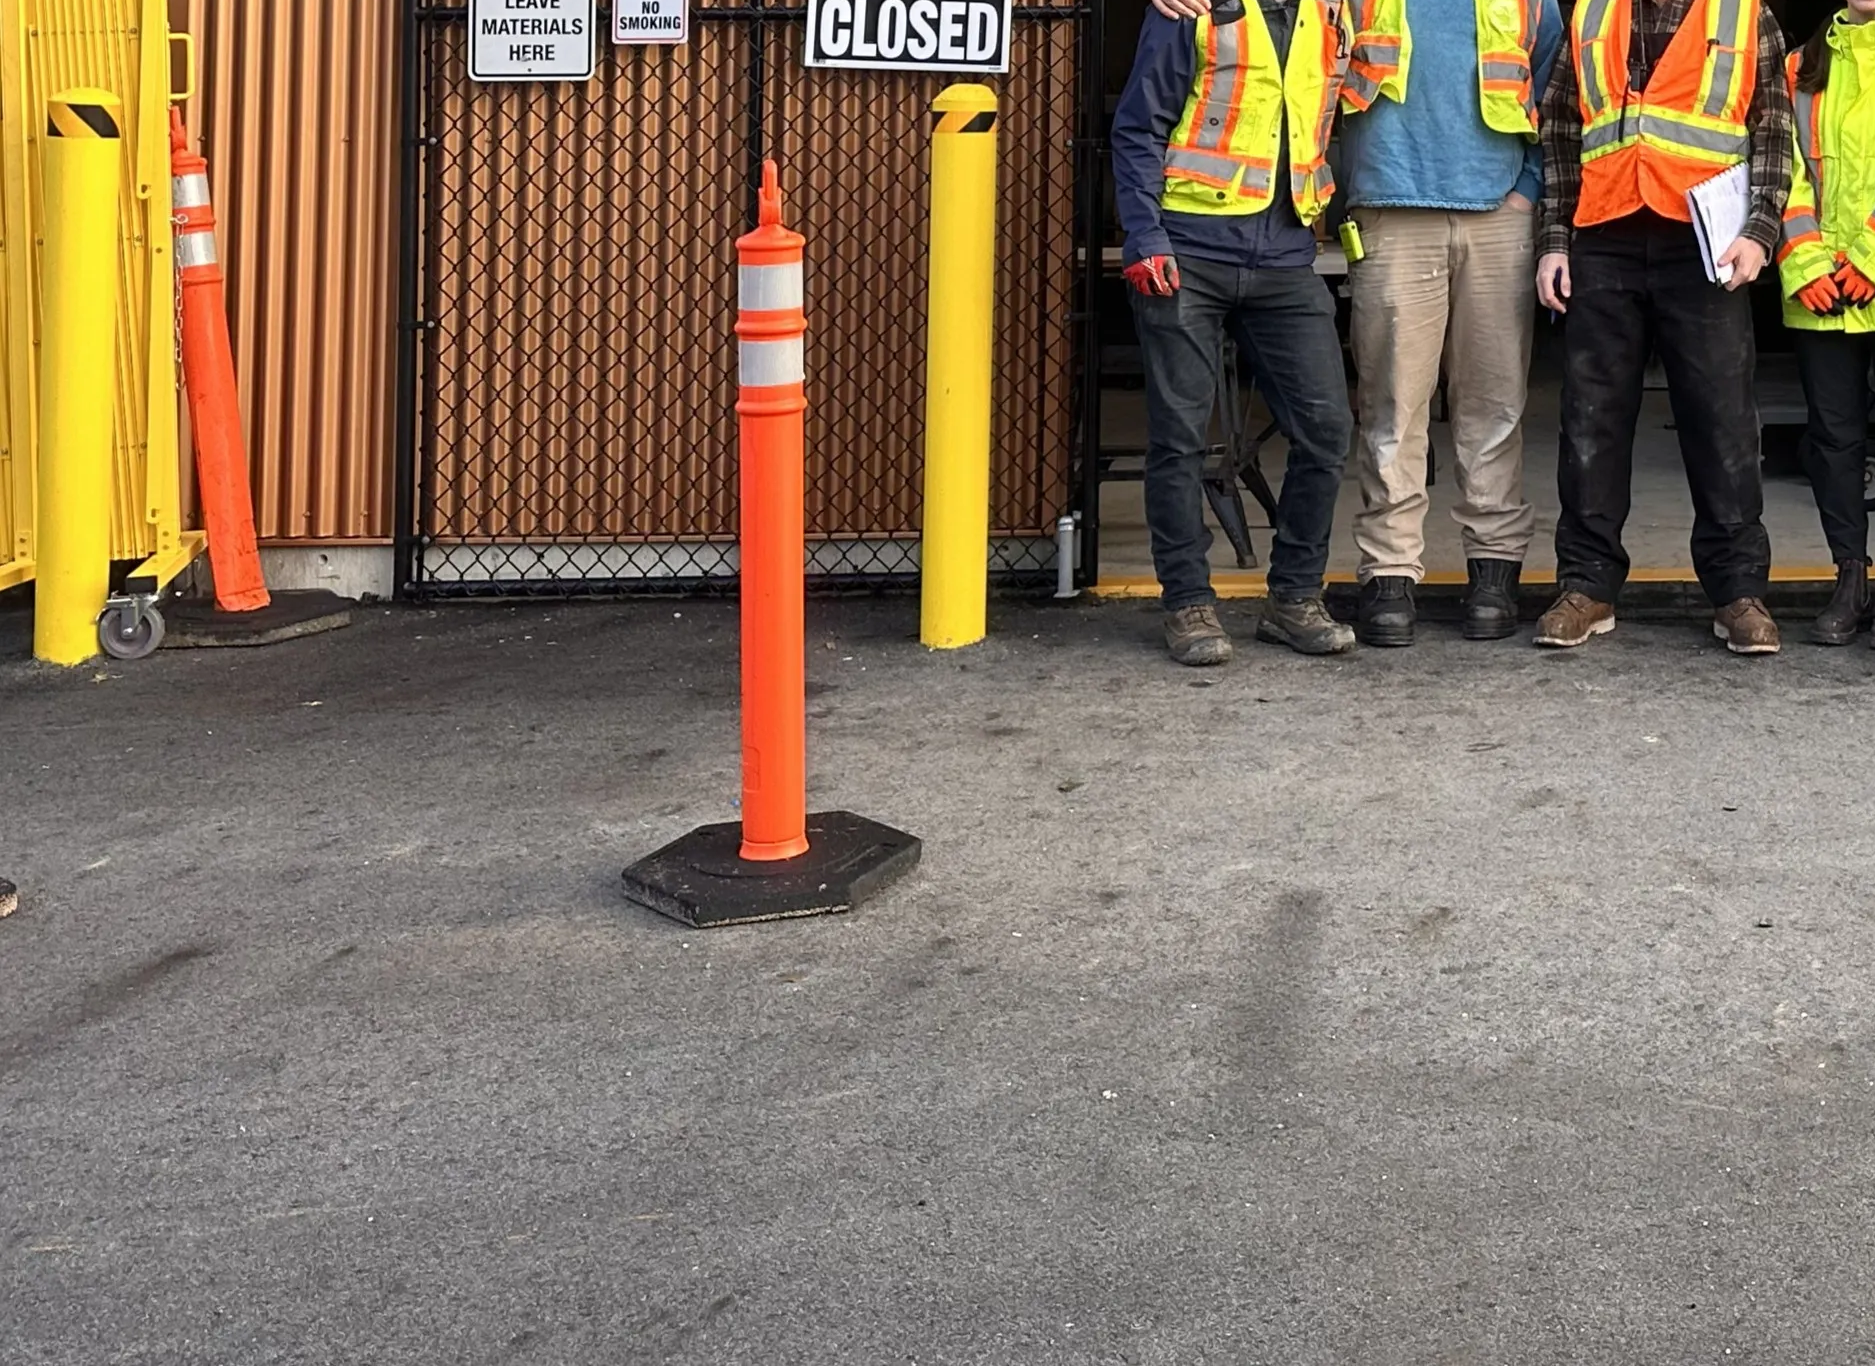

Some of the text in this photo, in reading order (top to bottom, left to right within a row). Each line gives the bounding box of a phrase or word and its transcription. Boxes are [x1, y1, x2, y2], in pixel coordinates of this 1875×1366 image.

[641, 1, 660, 15] NO
[482, 18, 583, 35] MATERIALS
[619, 16, 681, 30] SMOKING
[509, 44, 555, 61] HERE
